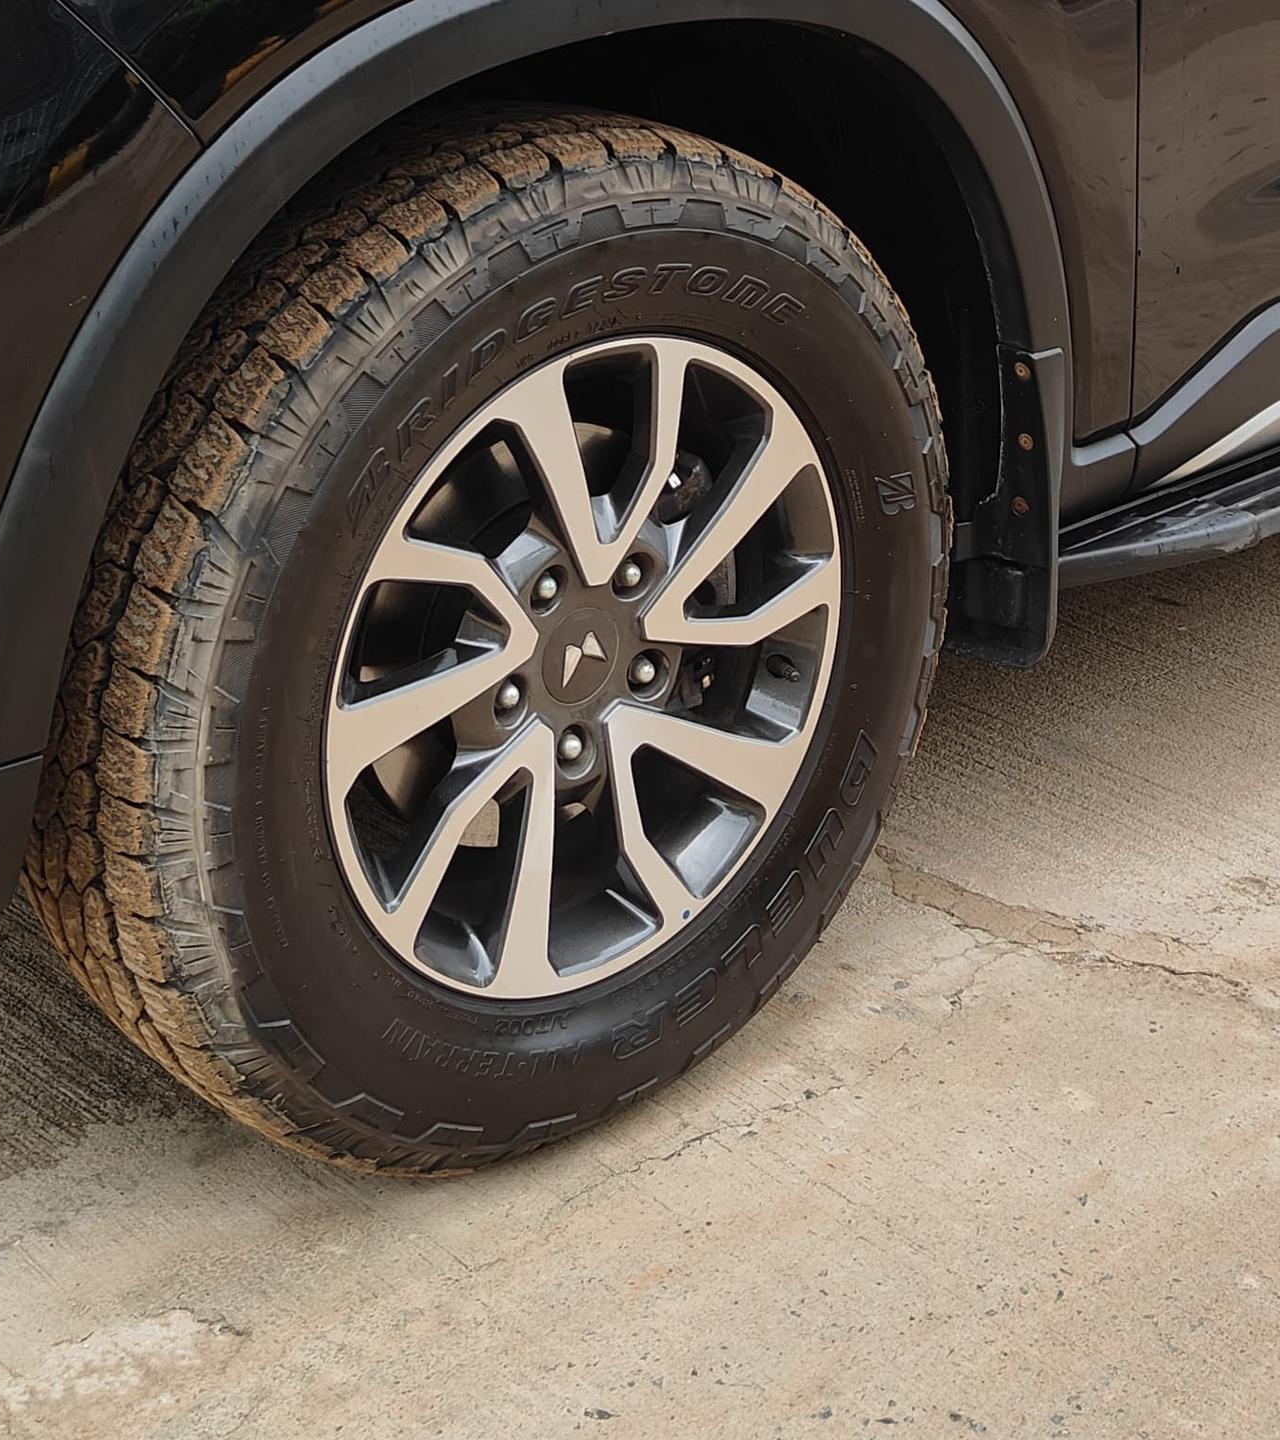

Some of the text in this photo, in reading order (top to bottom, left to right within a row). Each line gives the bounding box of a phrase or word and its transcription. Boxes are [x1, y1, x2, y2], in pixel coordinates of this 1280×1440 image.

[347, 263, 806, 536] BRIDGESTONE
[612, 728, 880, 1060] DUELER
[379, 1017, 585, 1081] ALL-TERRAIN
